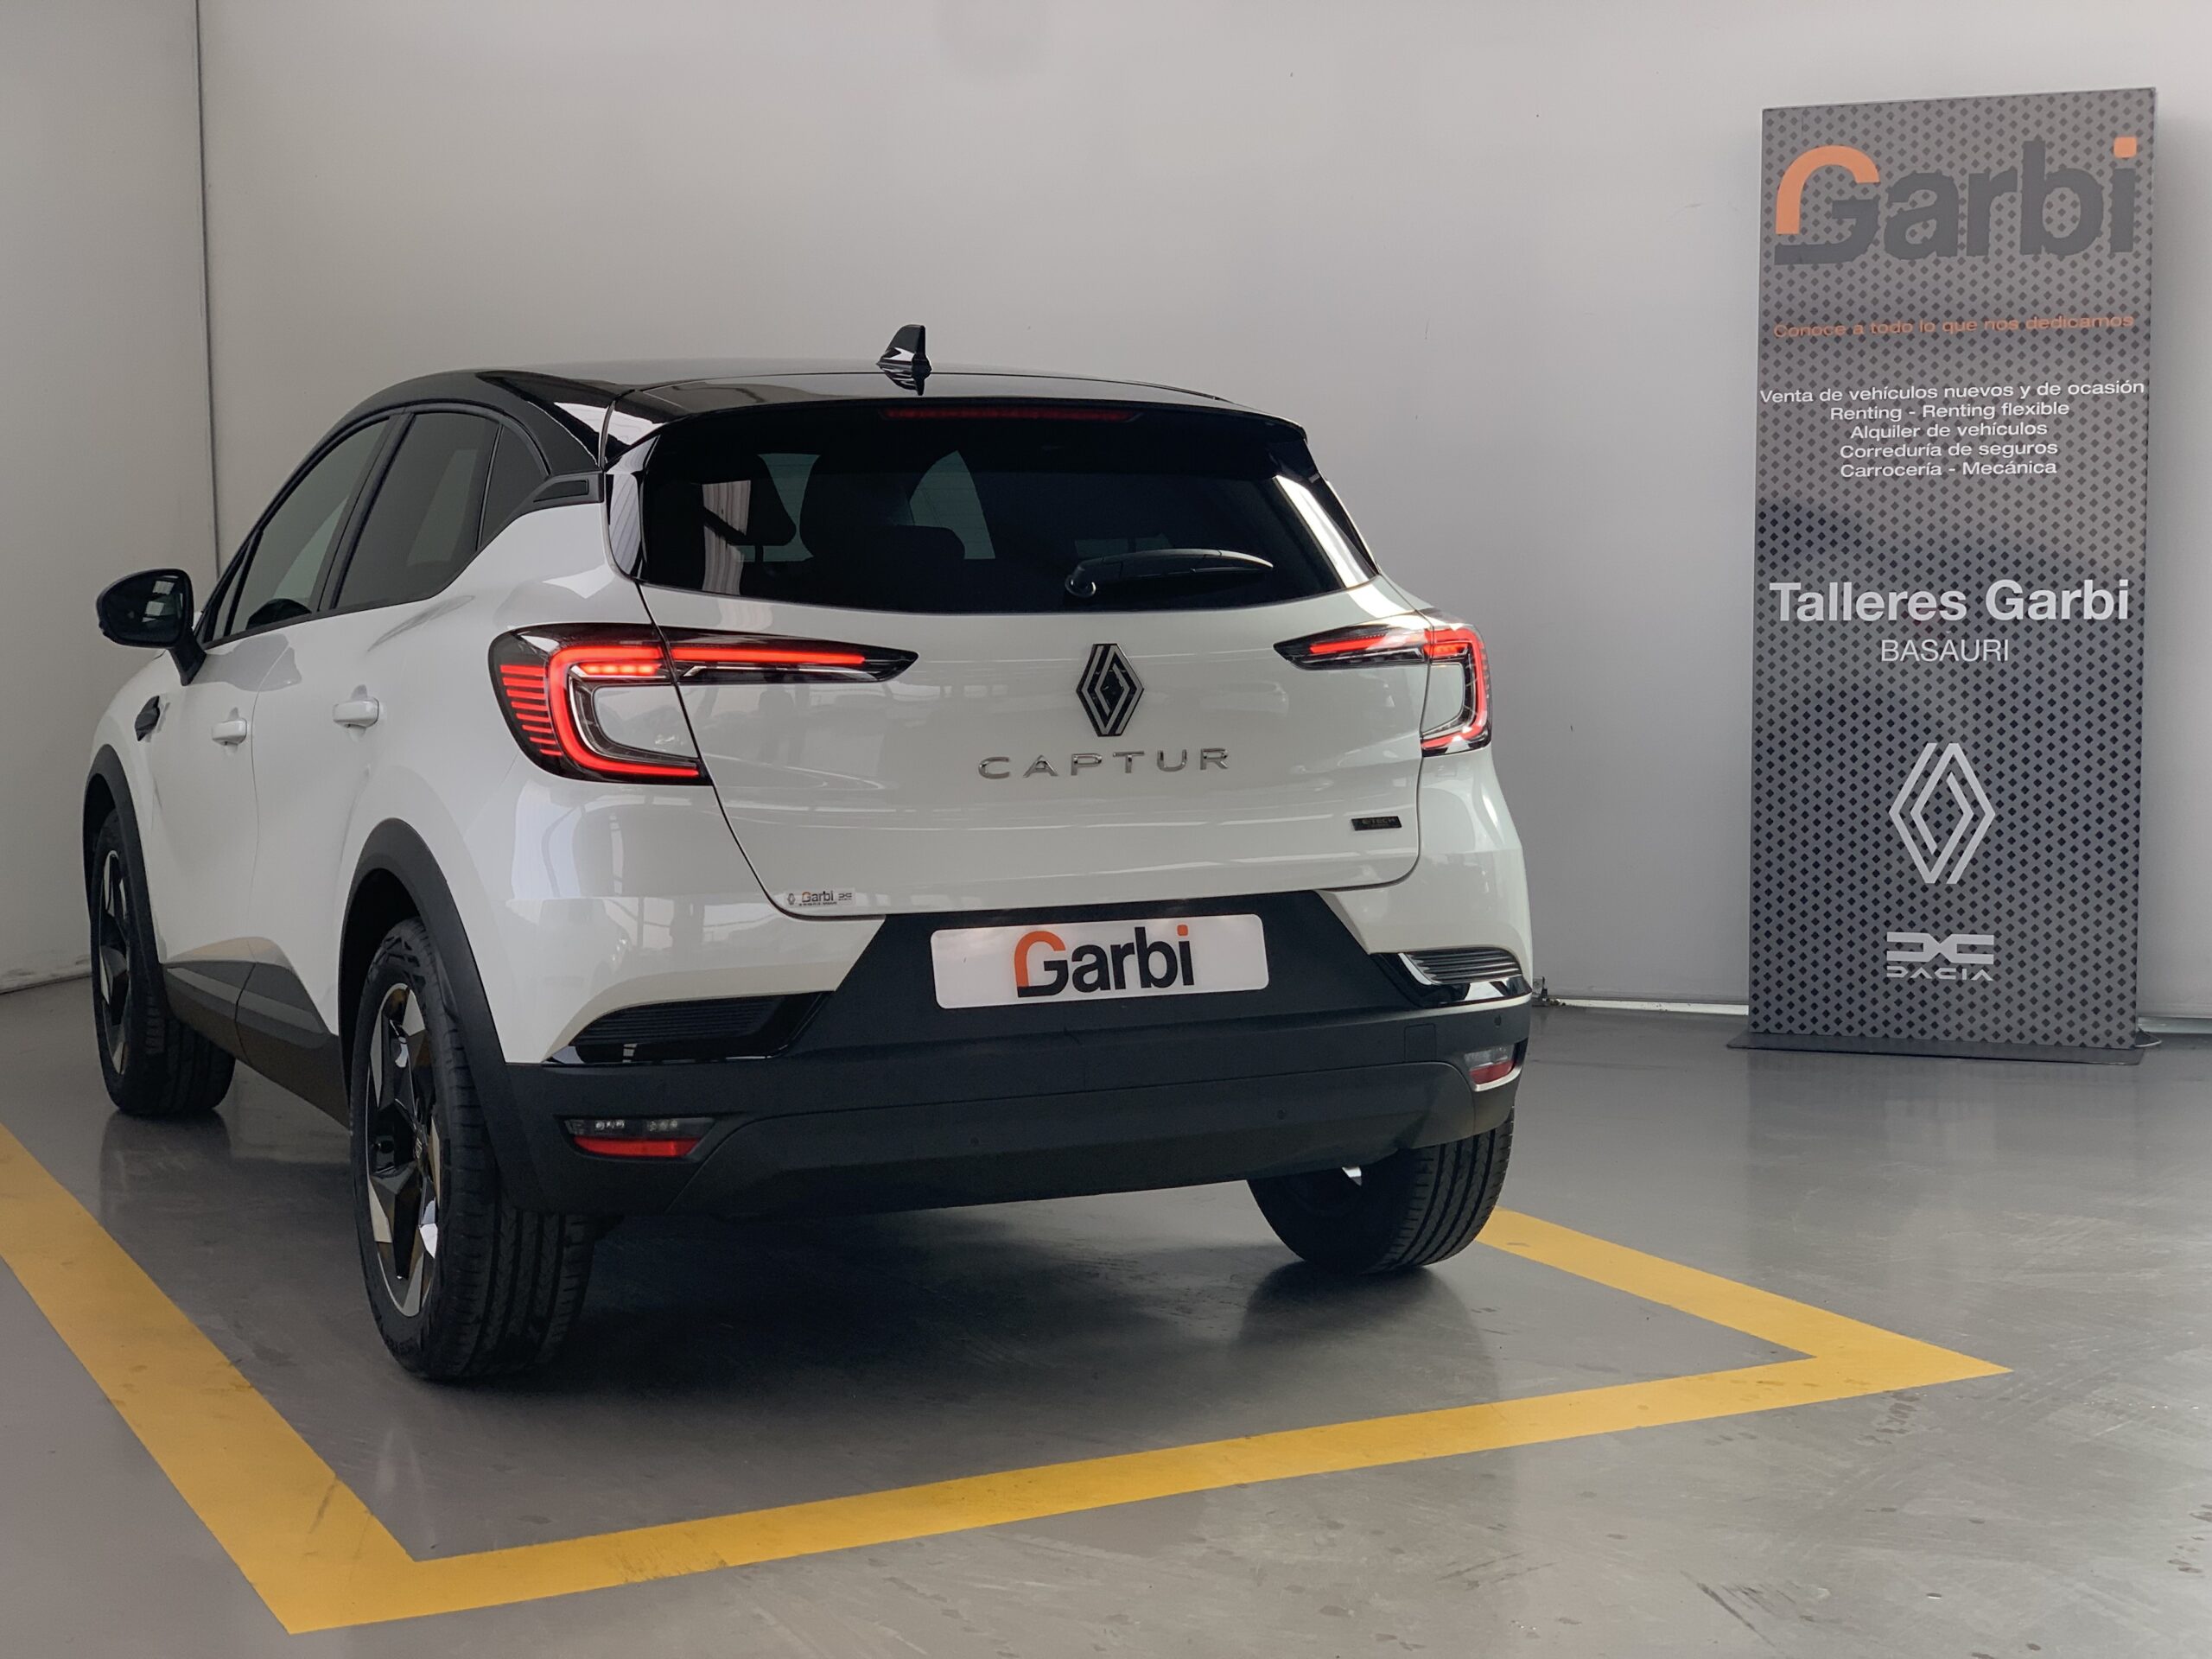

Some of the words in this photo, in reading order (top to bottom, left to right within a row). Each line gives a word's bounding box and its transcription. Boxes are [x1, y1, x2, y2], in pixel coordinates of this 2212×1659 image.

[1774, 137, 2137, 264] Garbi
[1774, 324, 1847, 338] Conoce
[1853, 324, 1864, 335] a
[1871, 321, 1913, 334] todo
[1919, 320, 1936, 333] lo
[1942, 319, 1977, 334] que
[1985, 319, 2019, 331] nos
[2025, 315, 2134, 330] dedicamos
[1760, 390, 1814, 403] Venta
[1819, 388, 1843, 401] de
[1849, 385, 1938, 401] vehículos
[1944, 385, 2013, 398] nuevos
[2019, 385, 2031, 399] y
[2037, 382, 2061, 396] de
[2068, 379, 2145, 395] ocasión
[1830, 407, 1902, 423] Renting
[1923, 403, 1995, 419] Renting
[2001, 401, 2069, 416] flexible
[1850, 425, 1920, 442] Alquiler
[1926, 423, 1951, 437] de
[1957, 422, 2048, 436] vehículos
[1840, 443, 1942, 459] Correduría
[1948, 442, 1972, 456] de
[1979, 442, 2058, 458] seguros
[1840, 462, 1942, 478] Carrocería
[1962, 461, 2057, 475] Mecánica
[1769, 581, 1967, 622] Talleres
[1986, 579, 2129, 621] Garbi
[1880, 639, 2009, 662] BASAURI
[978, 747, 1229, 779] CAPTUR
[802, 891, 834, 902] Garbi
[1013, 924, 1194, 998] Garbi
[1886, 965, 1993, 982] DACIA
